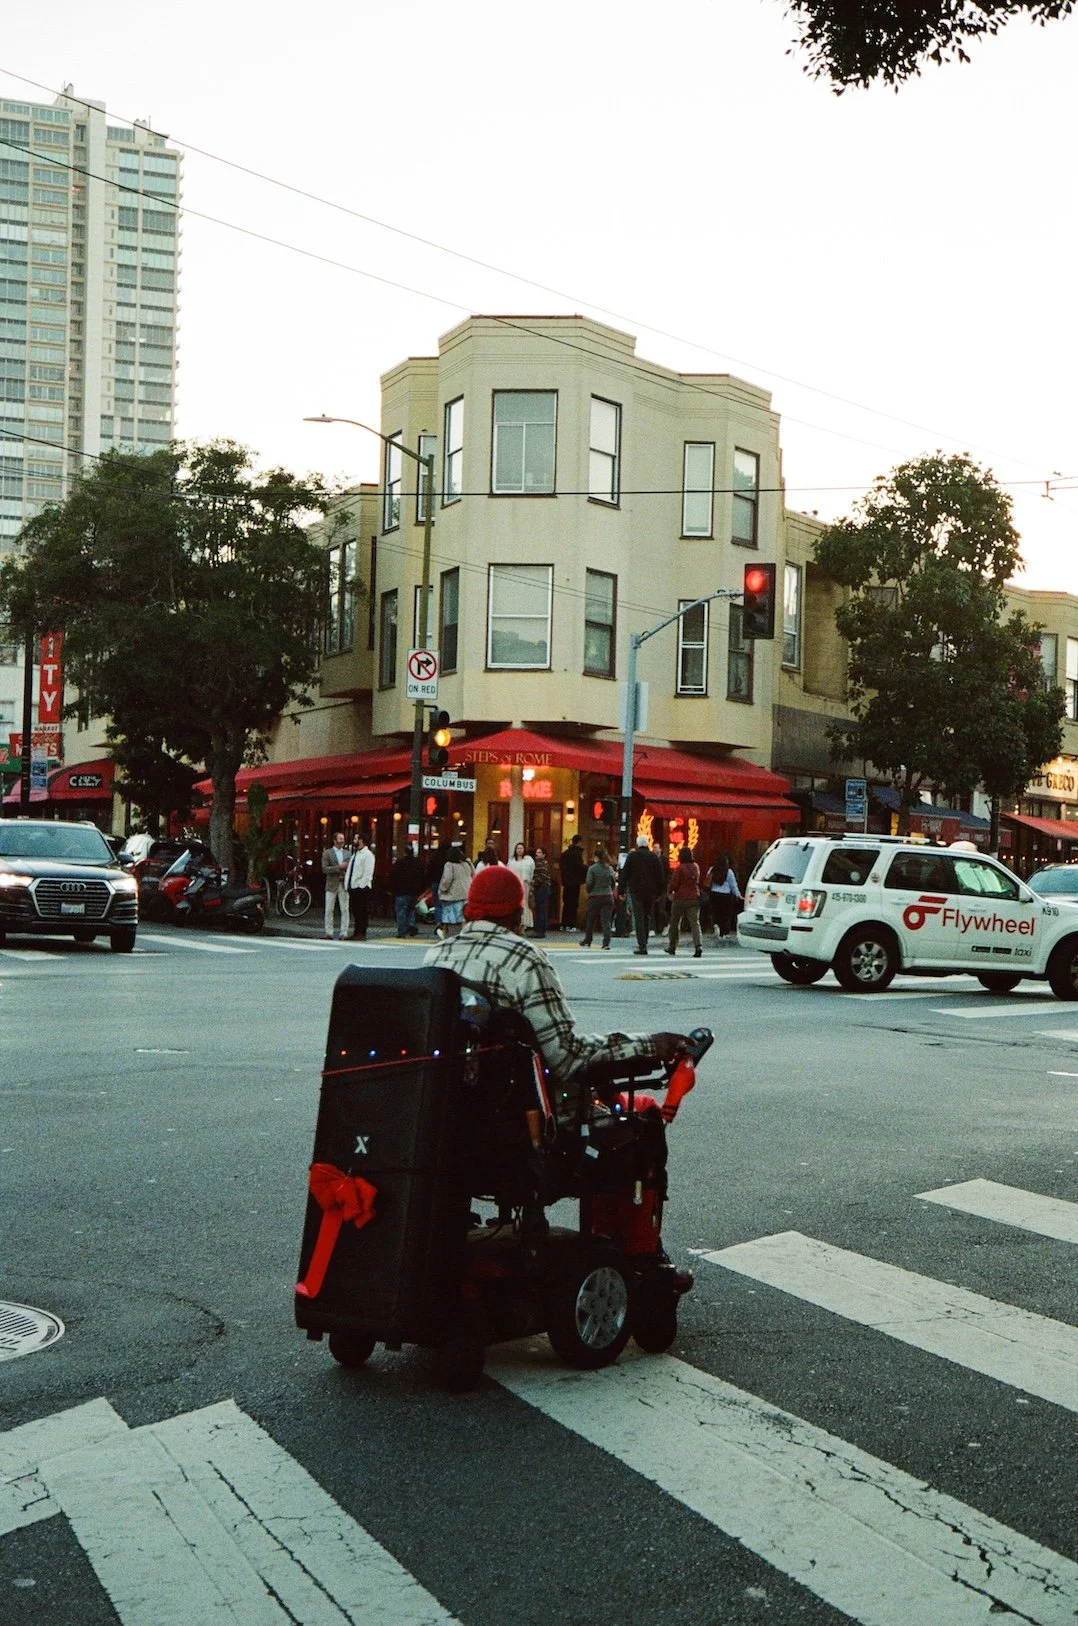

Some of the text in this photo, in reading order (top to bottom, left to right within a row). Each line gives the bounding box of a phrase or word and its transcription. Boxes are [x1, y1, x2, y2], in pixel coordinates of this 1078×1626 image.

[408, 684, 436, 694] ON RED
[465, 751, 498, 762] STEPS
[516, 753, 552, 764] ROME
[424, 778, 475, 790] COLUMBUS
[499, 780, 552, 798] RME
[941, 908, 1036, 936] Flywheel
[1014, 947, 1032, 958] taxi
